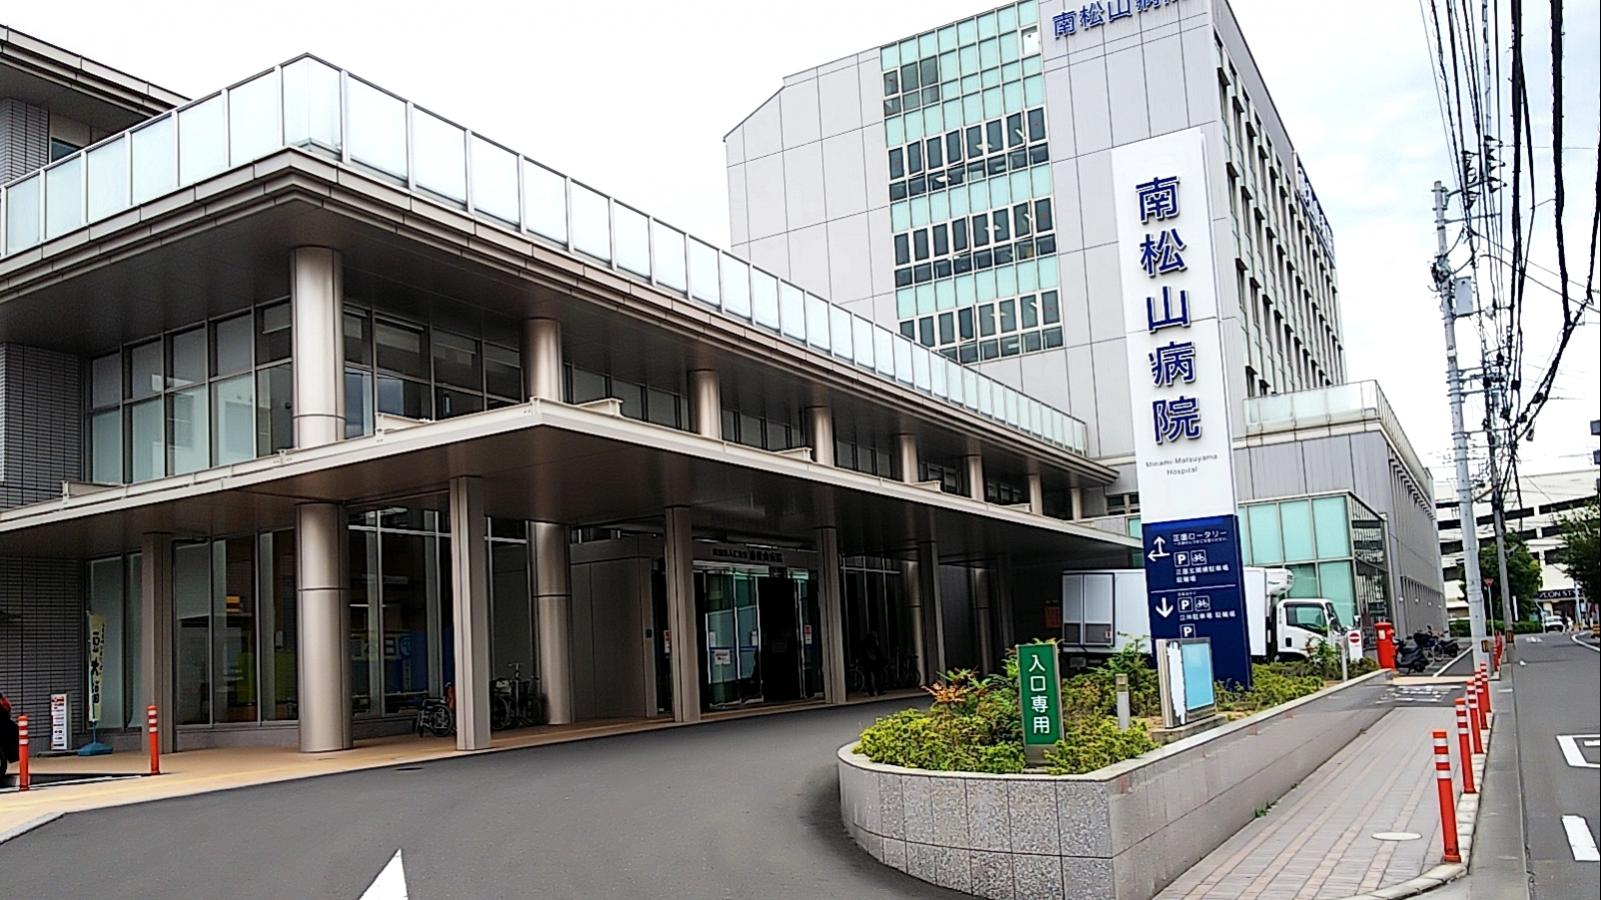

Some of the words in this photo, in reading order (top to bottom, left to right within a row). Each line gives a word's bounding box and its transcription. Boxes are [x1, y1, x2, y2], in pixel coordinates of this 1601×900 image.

[1053, 0, 1177, 39] 南松山
[1136, 176, 1201, 445] 南松山病院
[1174, 454, 1218, 464] Matsuyama
[1166, 466, 1198, 476] Hospital
[1177, 554, 1186, 565] P
[1181, 599, 1190, 610] P
[1183, 626, 1192, 637] P
[1028, 654, 1050, 734] 入口専用
